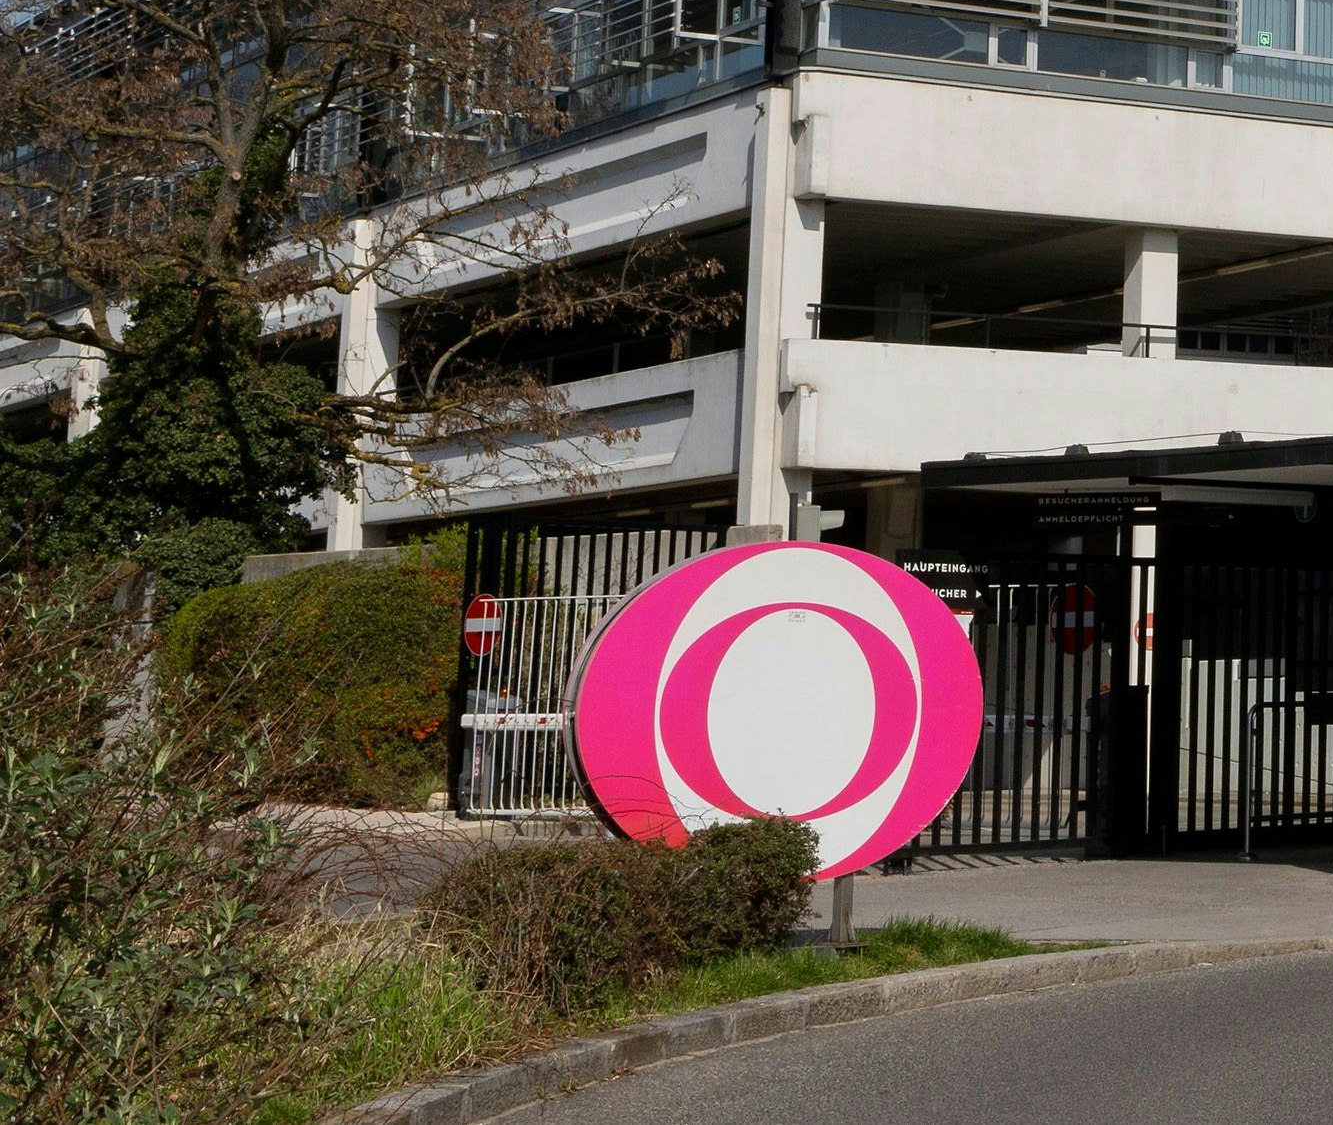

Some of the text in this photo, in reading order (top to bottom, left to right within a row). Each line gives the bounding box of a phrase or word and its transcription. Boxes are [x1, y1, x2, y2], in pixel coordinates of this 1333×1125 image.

[1038, 496, 1150, 505] BESUCHERANMELDUNG
[1038, 514, 1124, 523] ANMELDEPFLICHT
[903, 561, 989, 574] HAUPTEINGANG
[931, 588, 967, 599] UCHER
